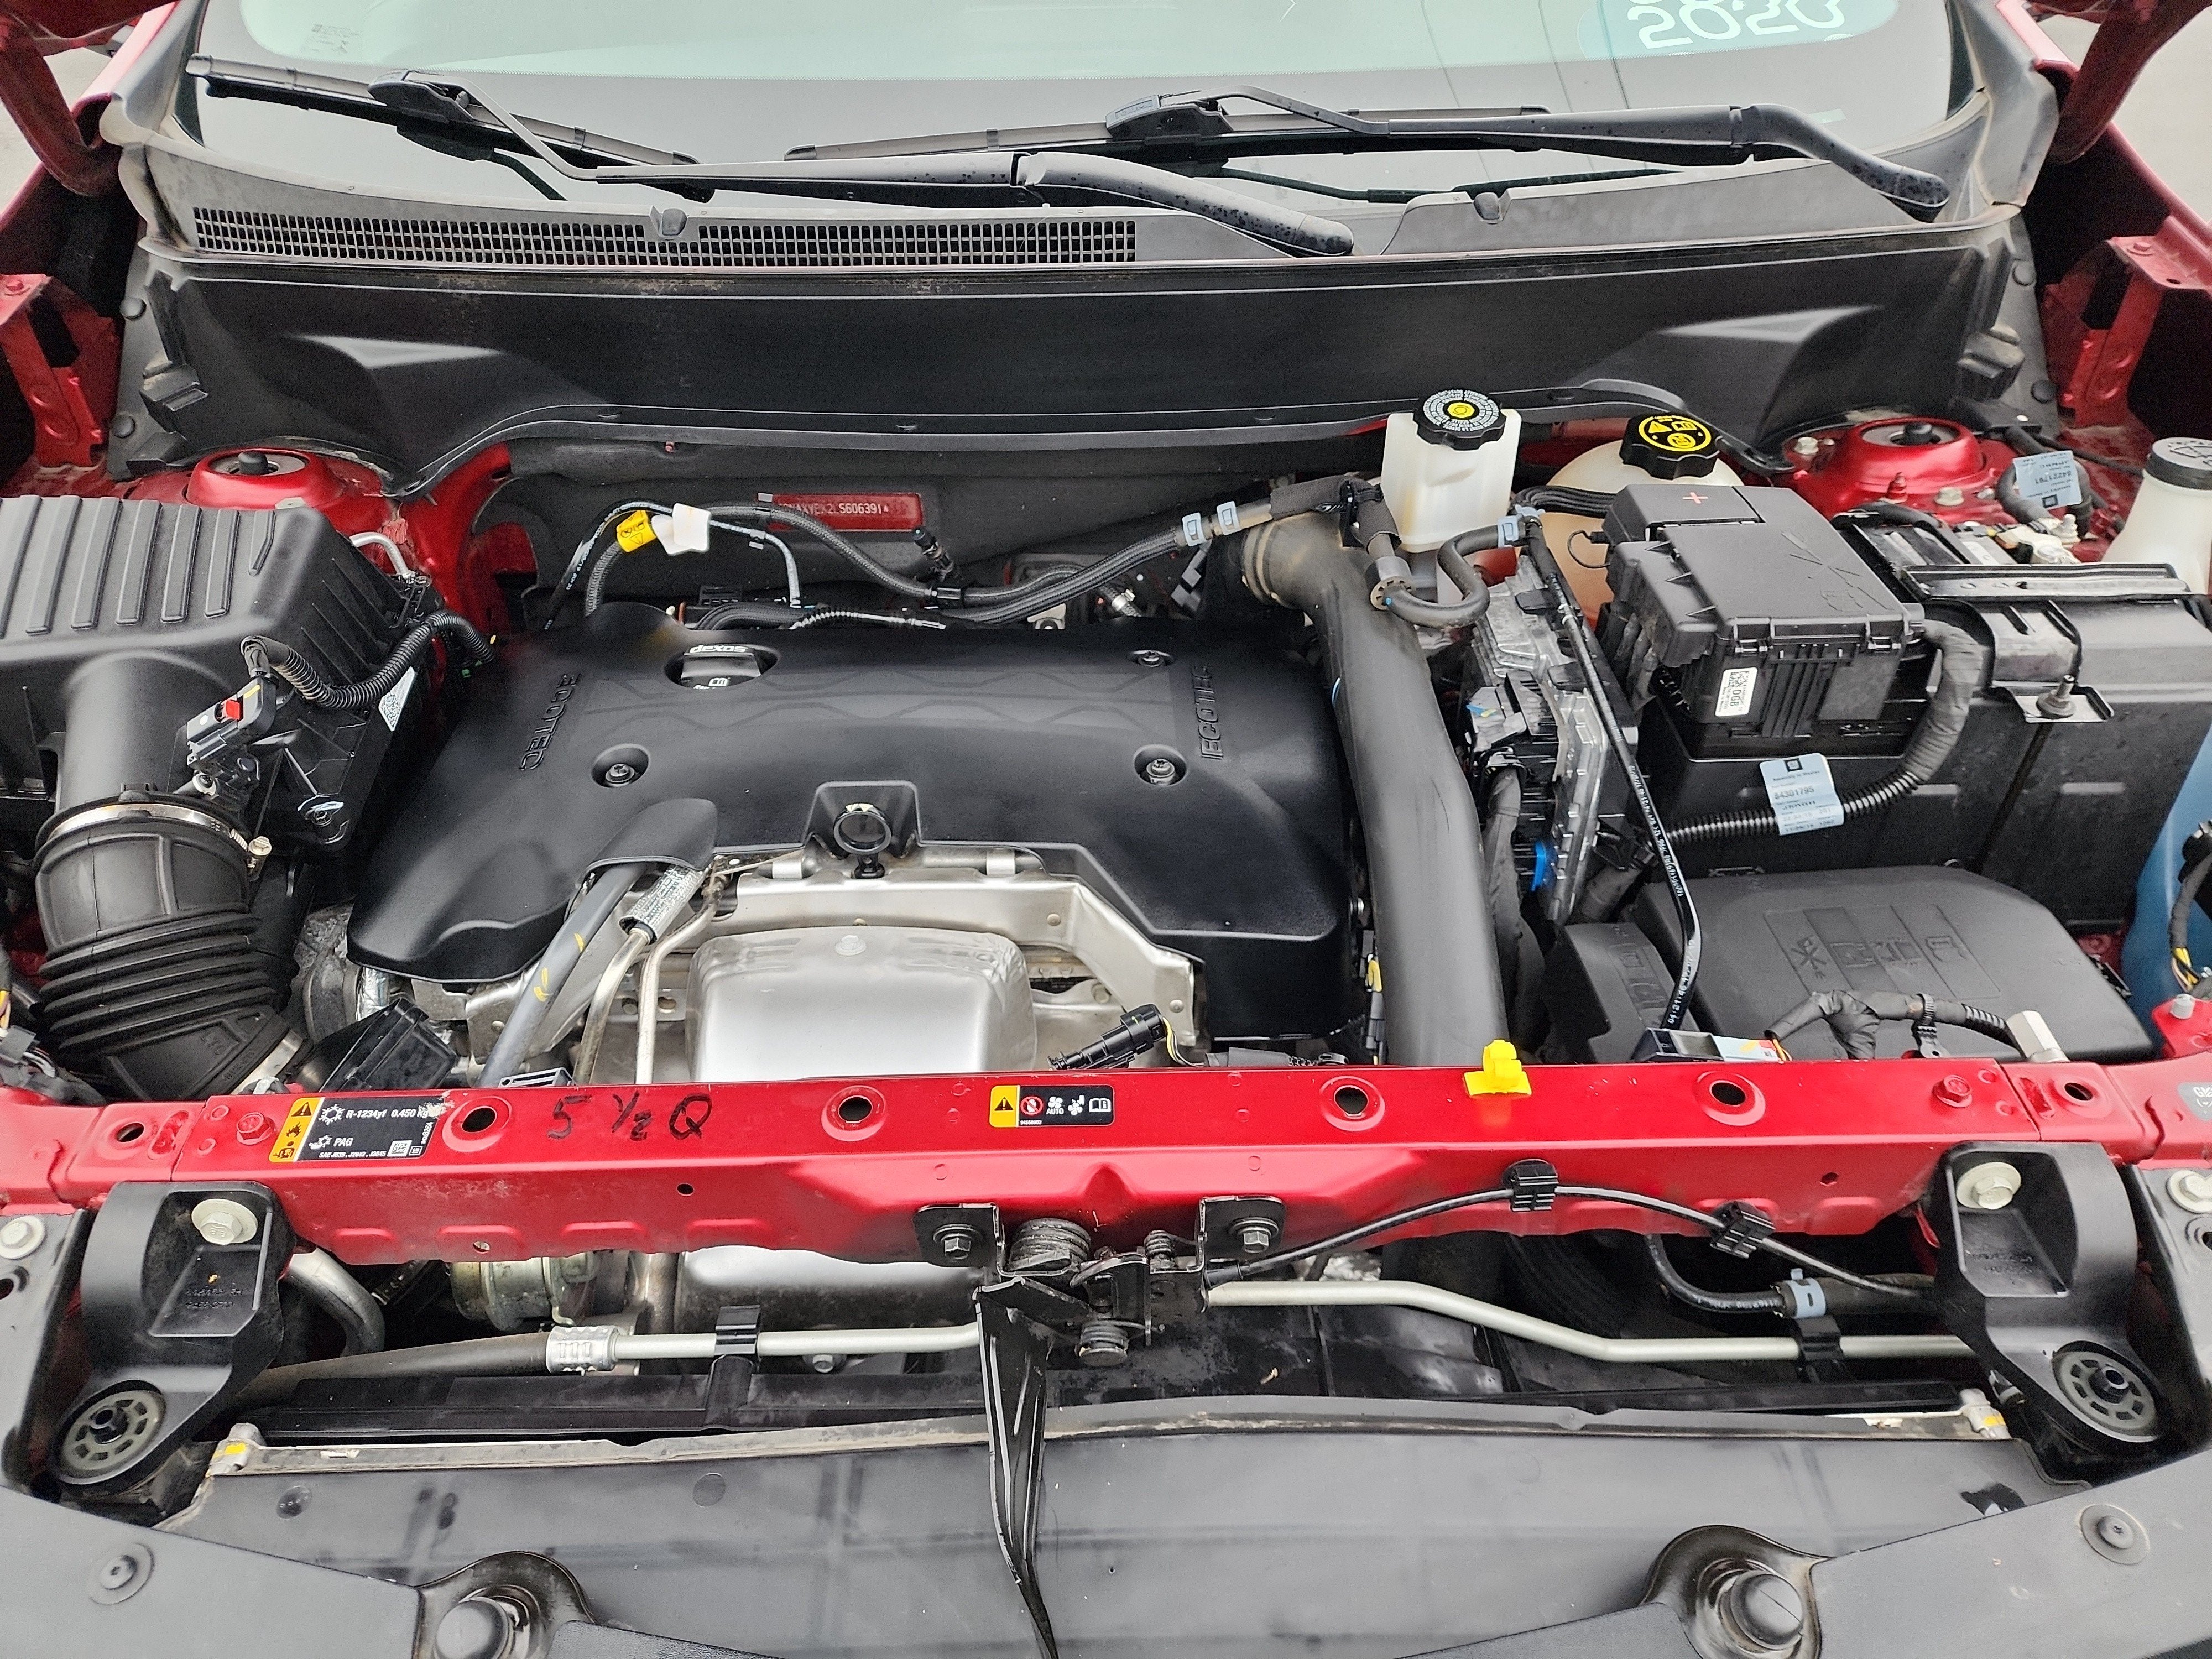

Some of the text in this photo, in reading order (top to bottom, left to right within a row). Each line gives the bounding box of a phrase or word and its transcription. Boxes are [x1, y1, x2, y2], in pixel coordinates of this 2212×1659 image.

[689, 644, 749, 654] dexos
[519, 672, 581, 771] ECOTEC
[1191, 665, 1224, 760] ECOTEC
[346, 1109, 387, 1119] R-1234yf
[391, 1109, 416, 1118] 0.450
[546, 1094, 592, 1140] 5
[669, 1092, 713, 1140] Q
[333, 1138, 354, 1147] PAG
